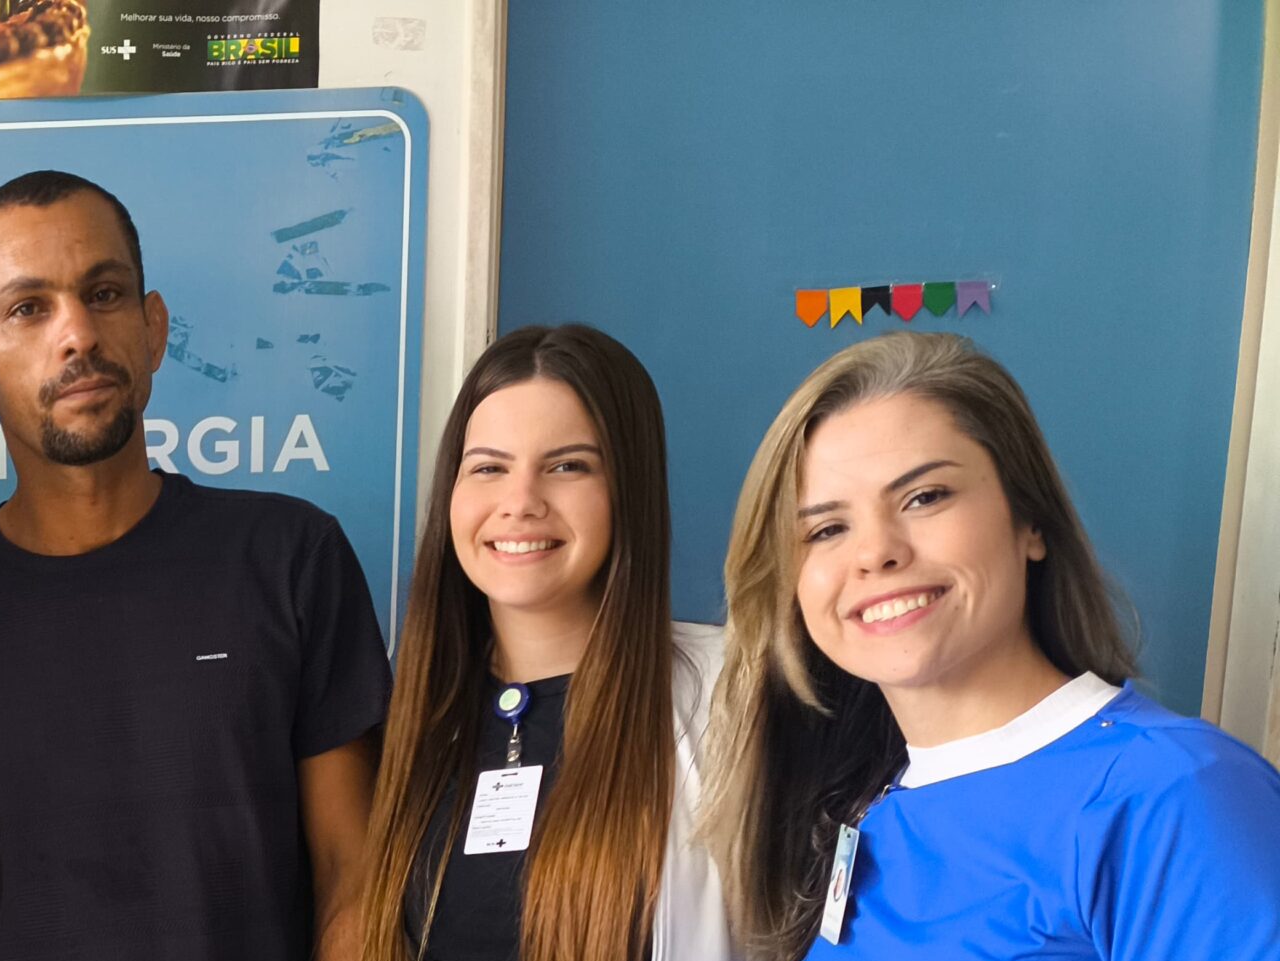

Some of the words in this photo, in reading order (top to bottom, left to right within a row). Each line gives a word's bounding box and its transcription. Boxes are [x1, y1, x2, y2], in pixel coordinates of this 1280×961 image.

[120, 13, 157, 22] Melhorar
[174, 13, 194, 23] vida,
[195, 15, 220, 23] nosso
[101, 46, 117, 54] SUS
[208, 38, 300, 60] BRASIL
[161, 50, 181, 58] Saúde
